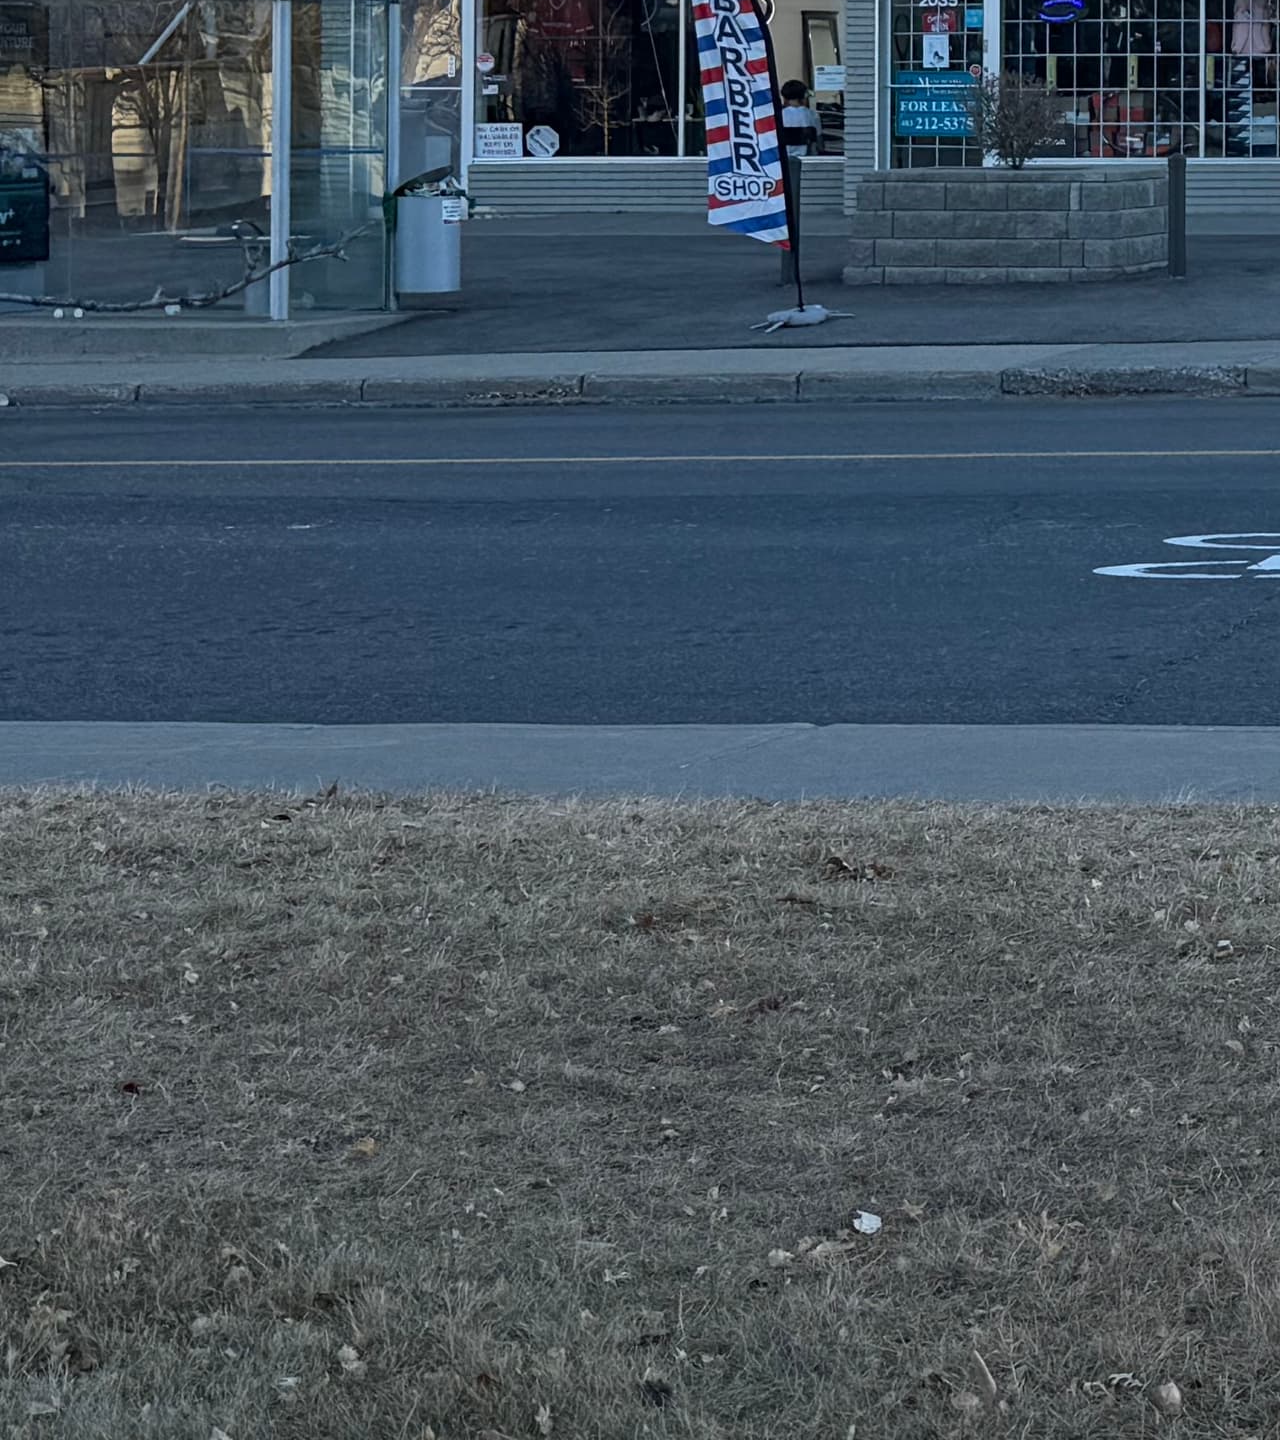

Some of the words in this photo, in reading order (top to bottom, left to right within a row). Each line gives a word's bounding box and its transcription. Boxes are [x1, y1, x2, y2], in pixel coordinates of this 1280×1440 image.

[900, 101, 928, 112] FOR
[915, 117, 975, 130] 212-5375
[716, 176, 775, 198] SHOP
